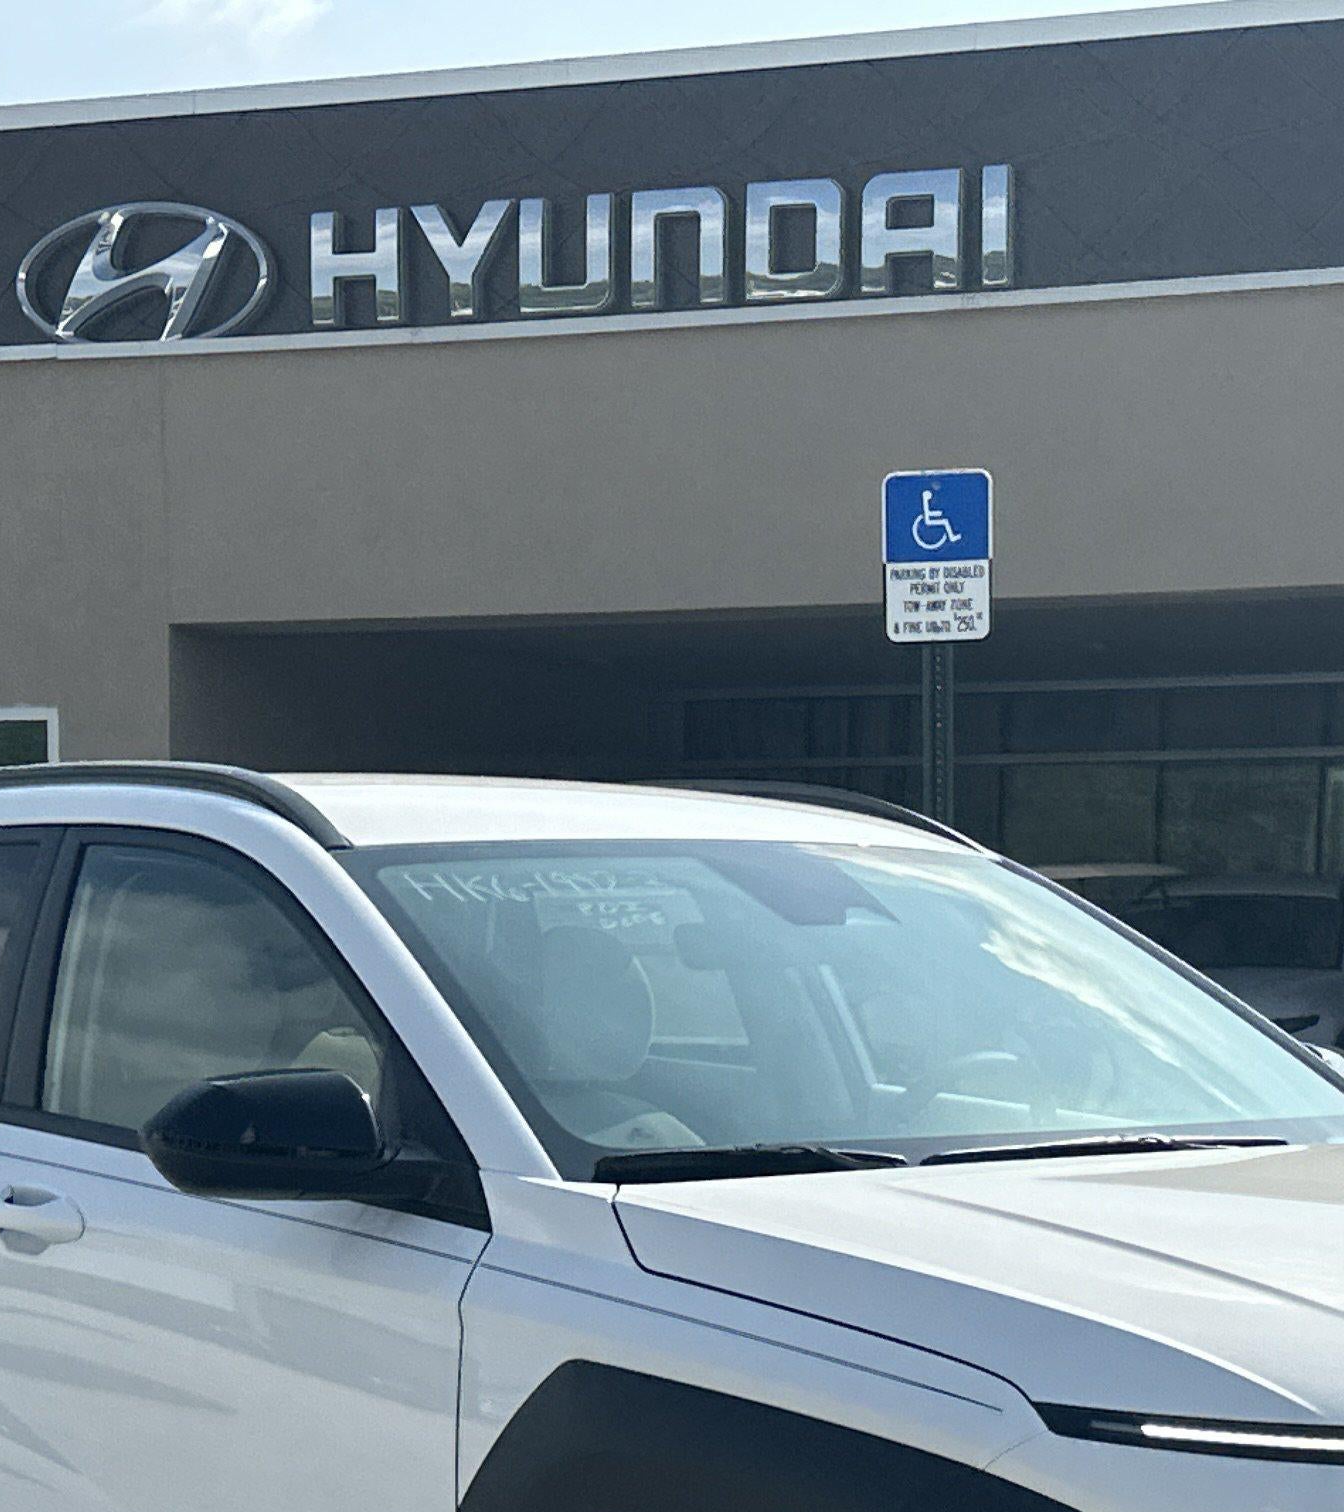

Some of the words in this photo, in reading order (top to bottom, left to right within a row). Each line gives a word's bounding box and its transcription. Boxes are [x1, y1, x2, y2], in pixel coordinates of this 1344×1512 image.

[310, 163, 1014, 325] HYUNDAI
[928, 566, 941, 580] BY
[943, 564, 986, 578] DISABLED
[909, 581, 940, 595] PERMIT
[943, 580, 966, 594] ONLY
[950, 597, 973, 611] ZONE
[903, 620, 923, 634] FINE
